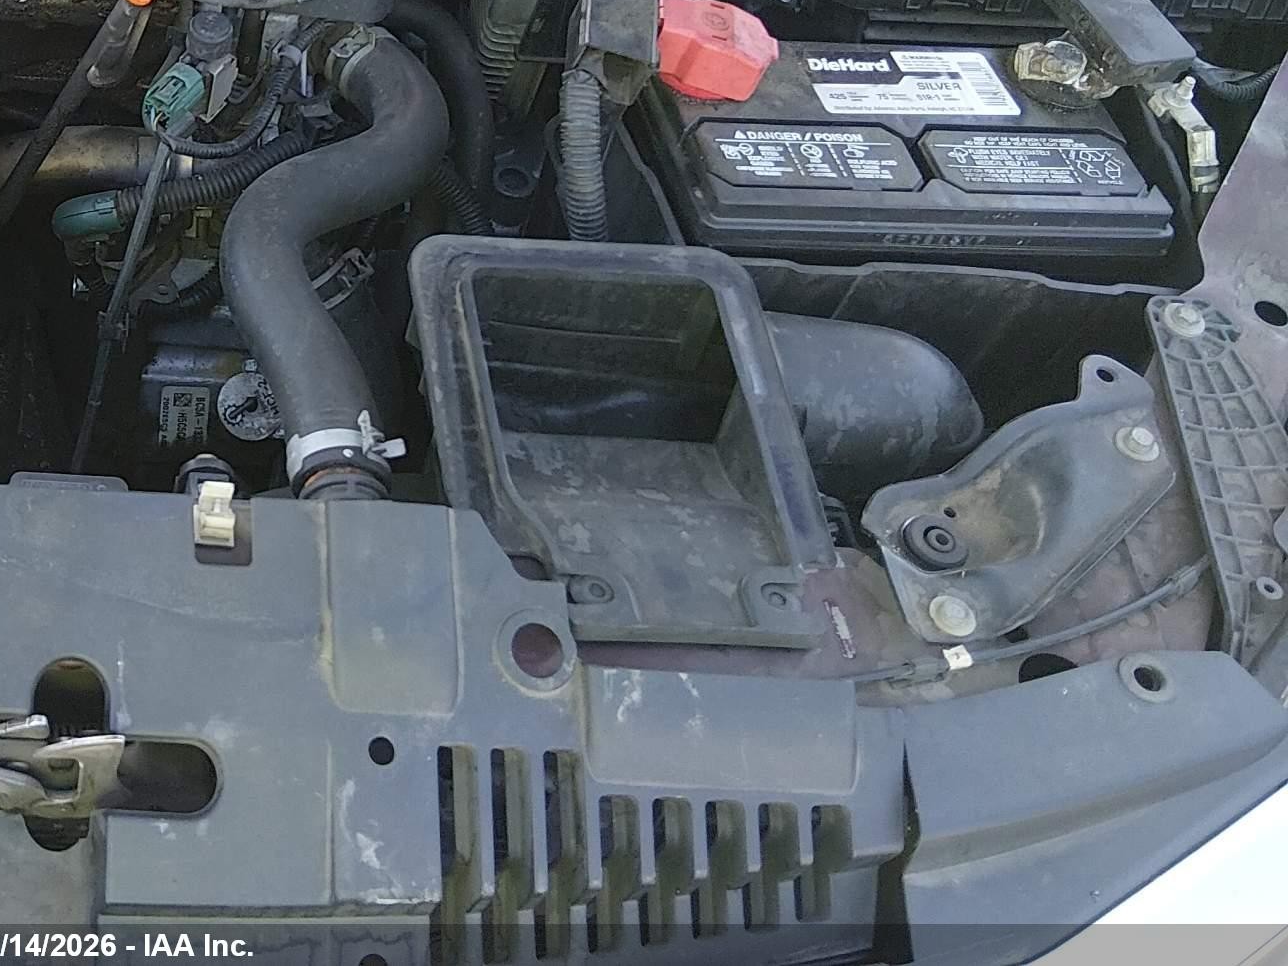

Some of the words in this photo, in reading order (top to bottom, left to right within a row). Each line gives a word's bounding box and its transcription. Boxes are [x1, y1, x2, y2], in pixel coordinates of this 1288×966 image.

[807, 58, 891, 72] DieHard
[916, 82, 962, 91] SILVER
[745, 131, 802, 140] DANGER
[804, 132, 811, 141] /
[813, 132, 863, 142] POISON
